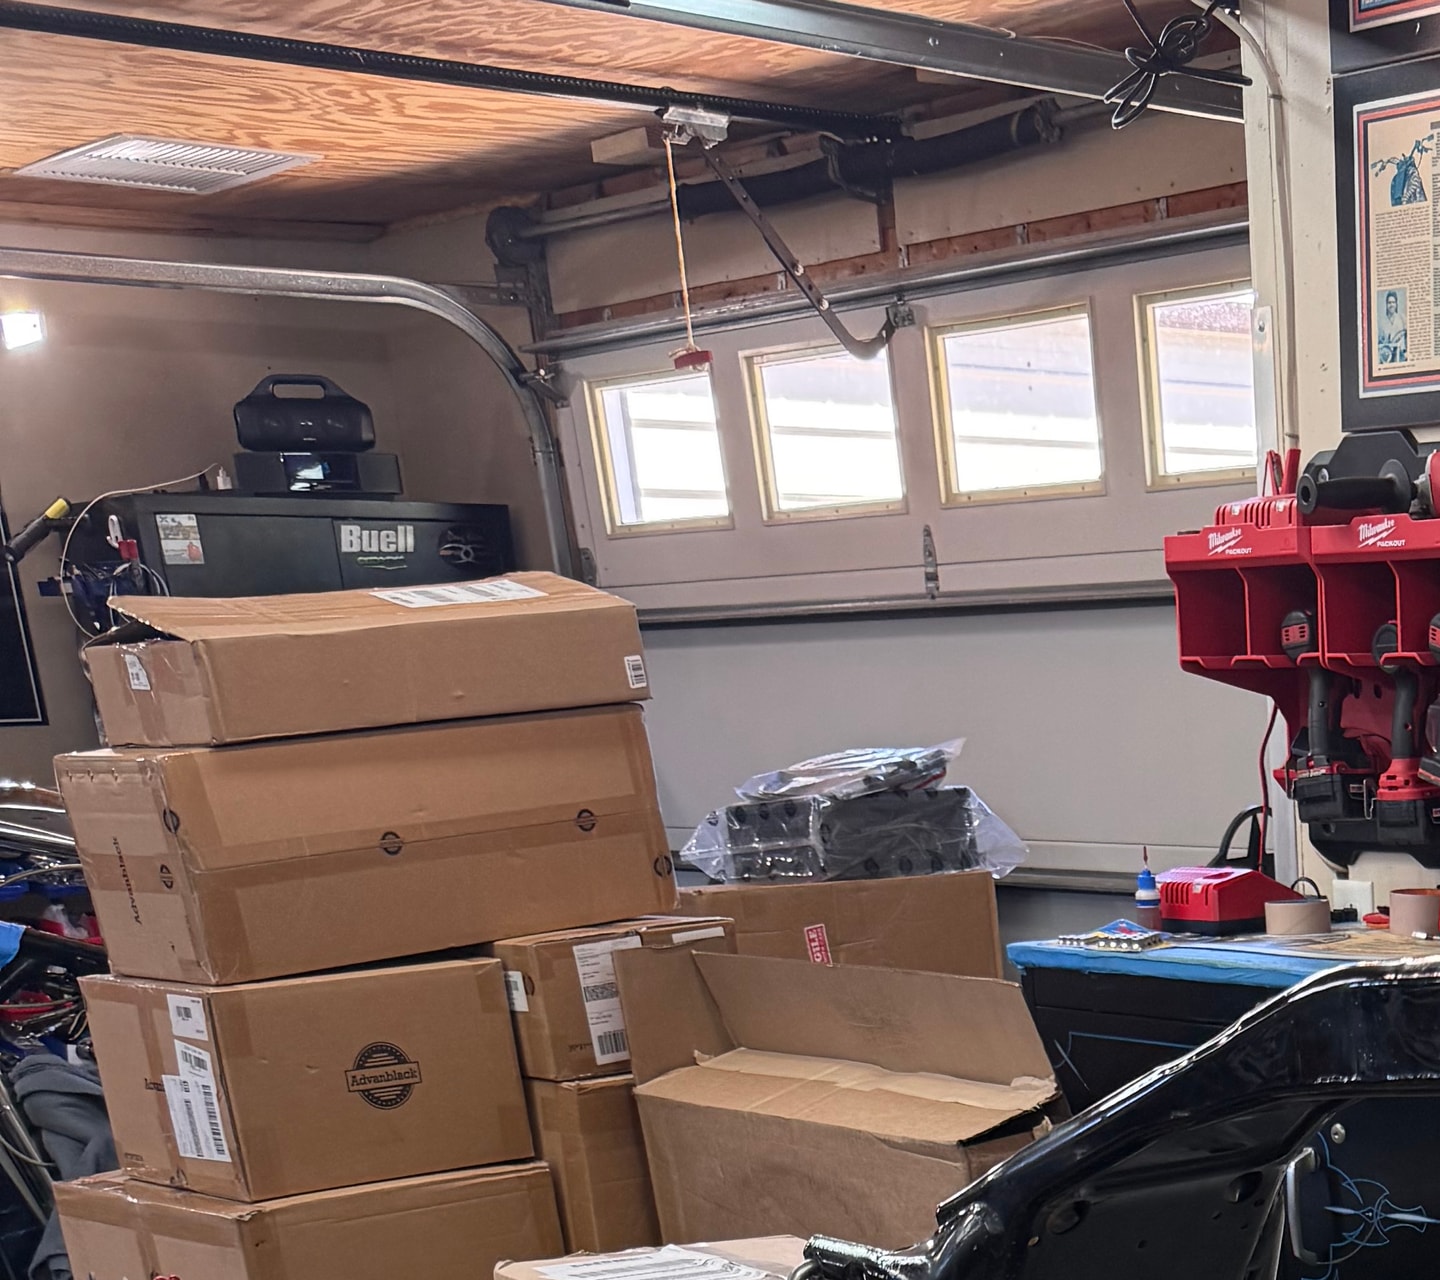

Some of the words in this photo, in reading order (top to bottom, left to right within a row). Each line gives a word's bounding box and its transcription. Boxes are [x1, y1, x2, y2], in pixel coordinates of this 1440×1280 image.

[341, 525, 414, 552] Buell
[1208, 527, 1242, 550] Milwaukee
[1359, 518, 1395, 541] Milwaukee
[1376, 539, 1406, 547] PACKOUT
[351, 1068, 418, 1087] Advanblack
